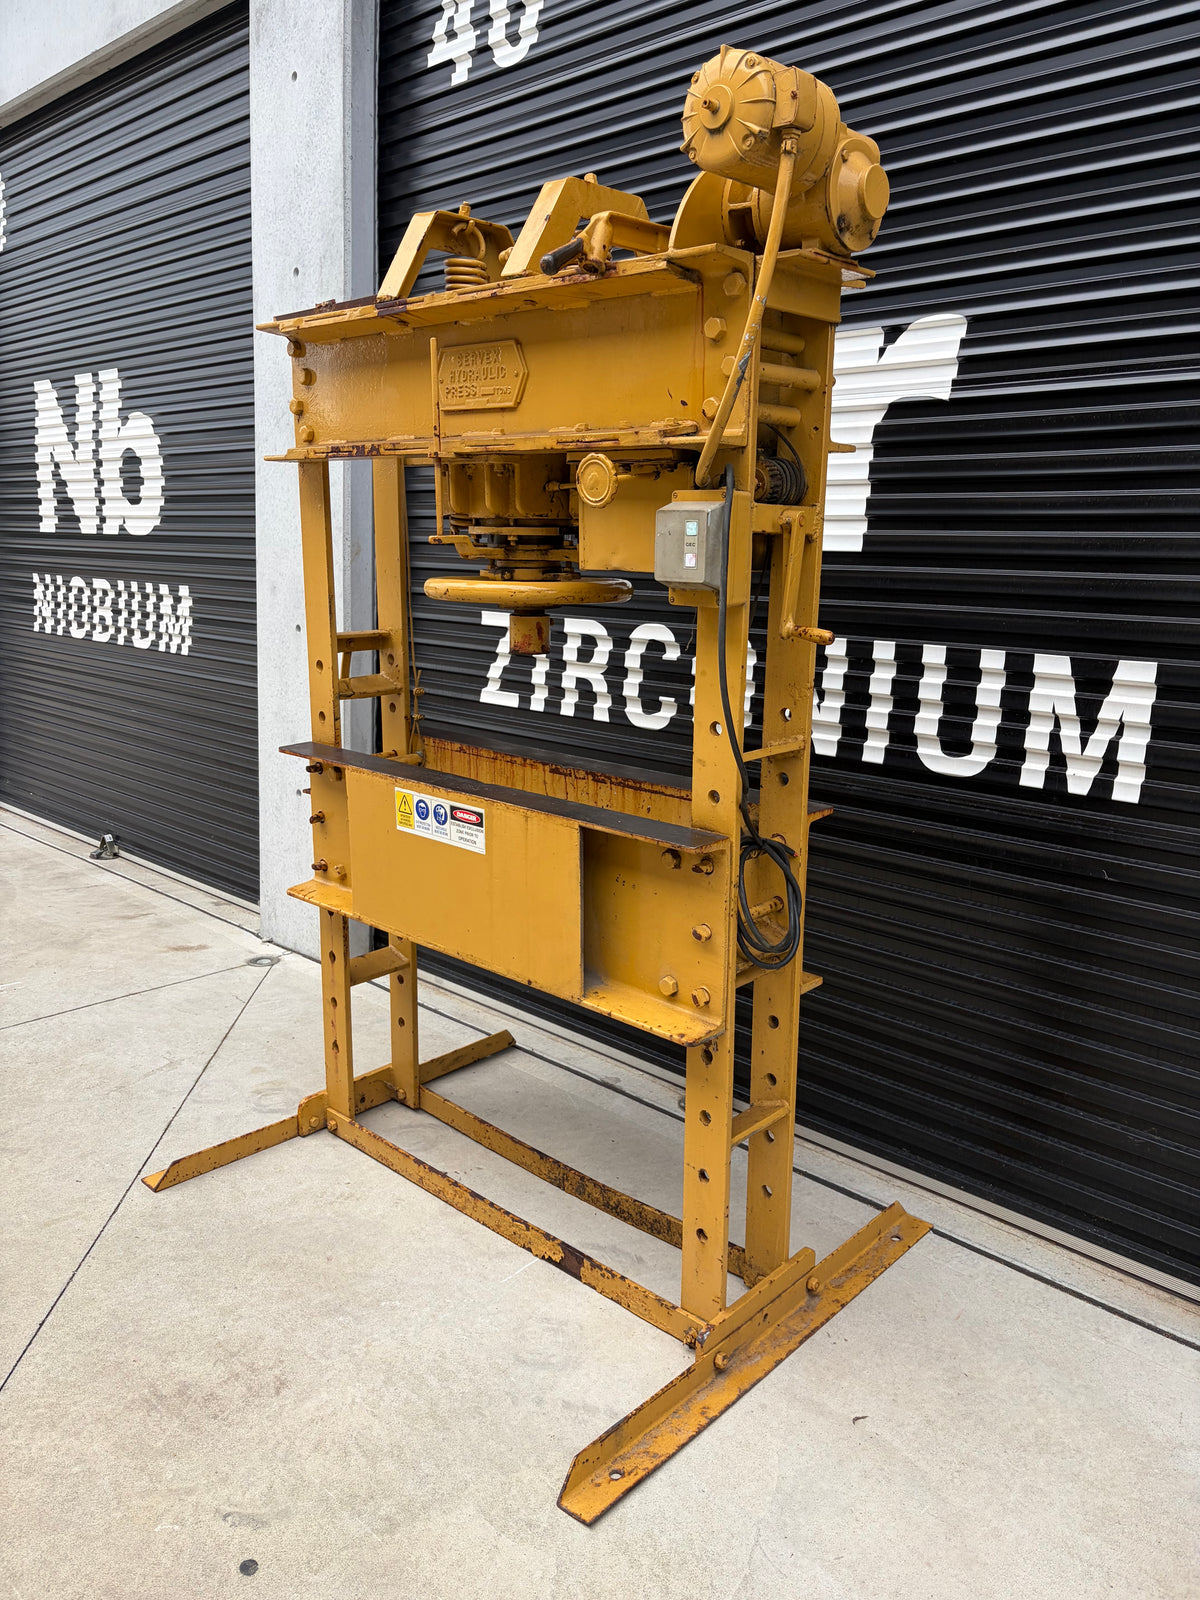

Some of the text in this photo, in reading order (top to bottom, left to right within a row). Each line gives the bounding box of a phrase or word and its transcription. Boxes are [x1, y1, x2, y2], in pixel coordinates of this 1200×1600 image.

[450, 366, 507, 384] HYDRAULIC
[457, 347, 502, 367] SERVEX
[445, 384, 478, 399] PRESS
[33, 368, 165, 536] Nb
[32, 573, 193, 656] NIOBIUM
[480, 611, 1157, 804] ZIRCNIUM
